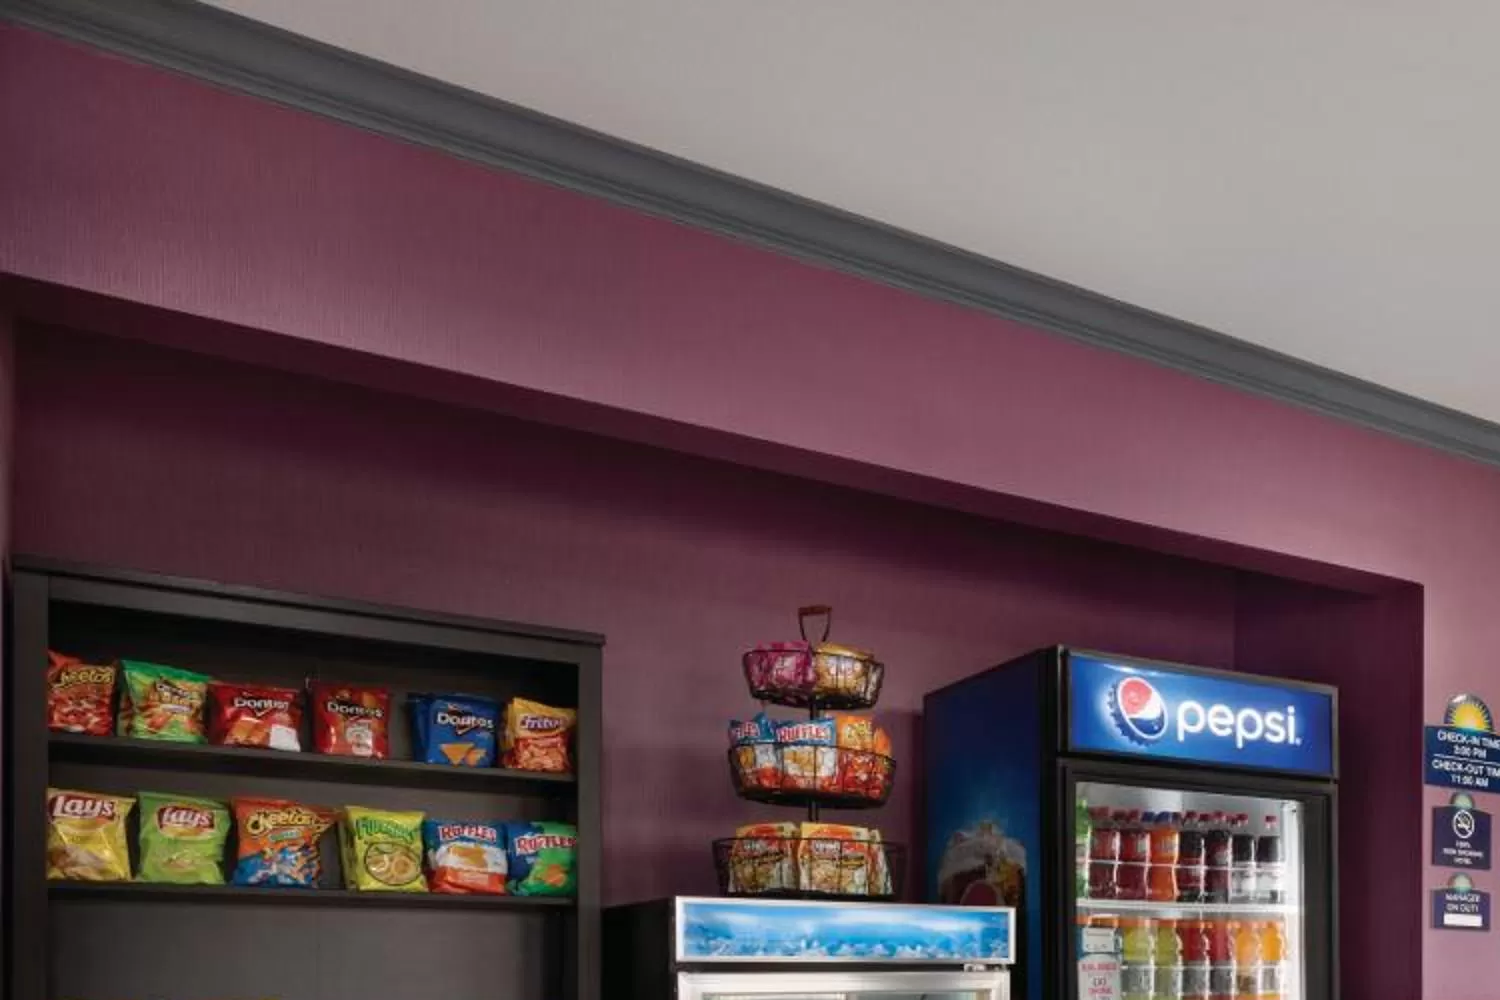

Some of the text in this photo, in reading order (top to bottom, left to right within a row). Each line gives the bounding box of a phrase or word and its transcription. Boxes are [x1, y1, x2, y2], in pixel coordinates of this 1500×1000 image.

[437, 711, 494, 729] Doritos
[1473, 747, 1487, 759] PM
[1431, 759, 1485, 776] CHECK-OUT
[1475, 777, 1489, 788] AM
